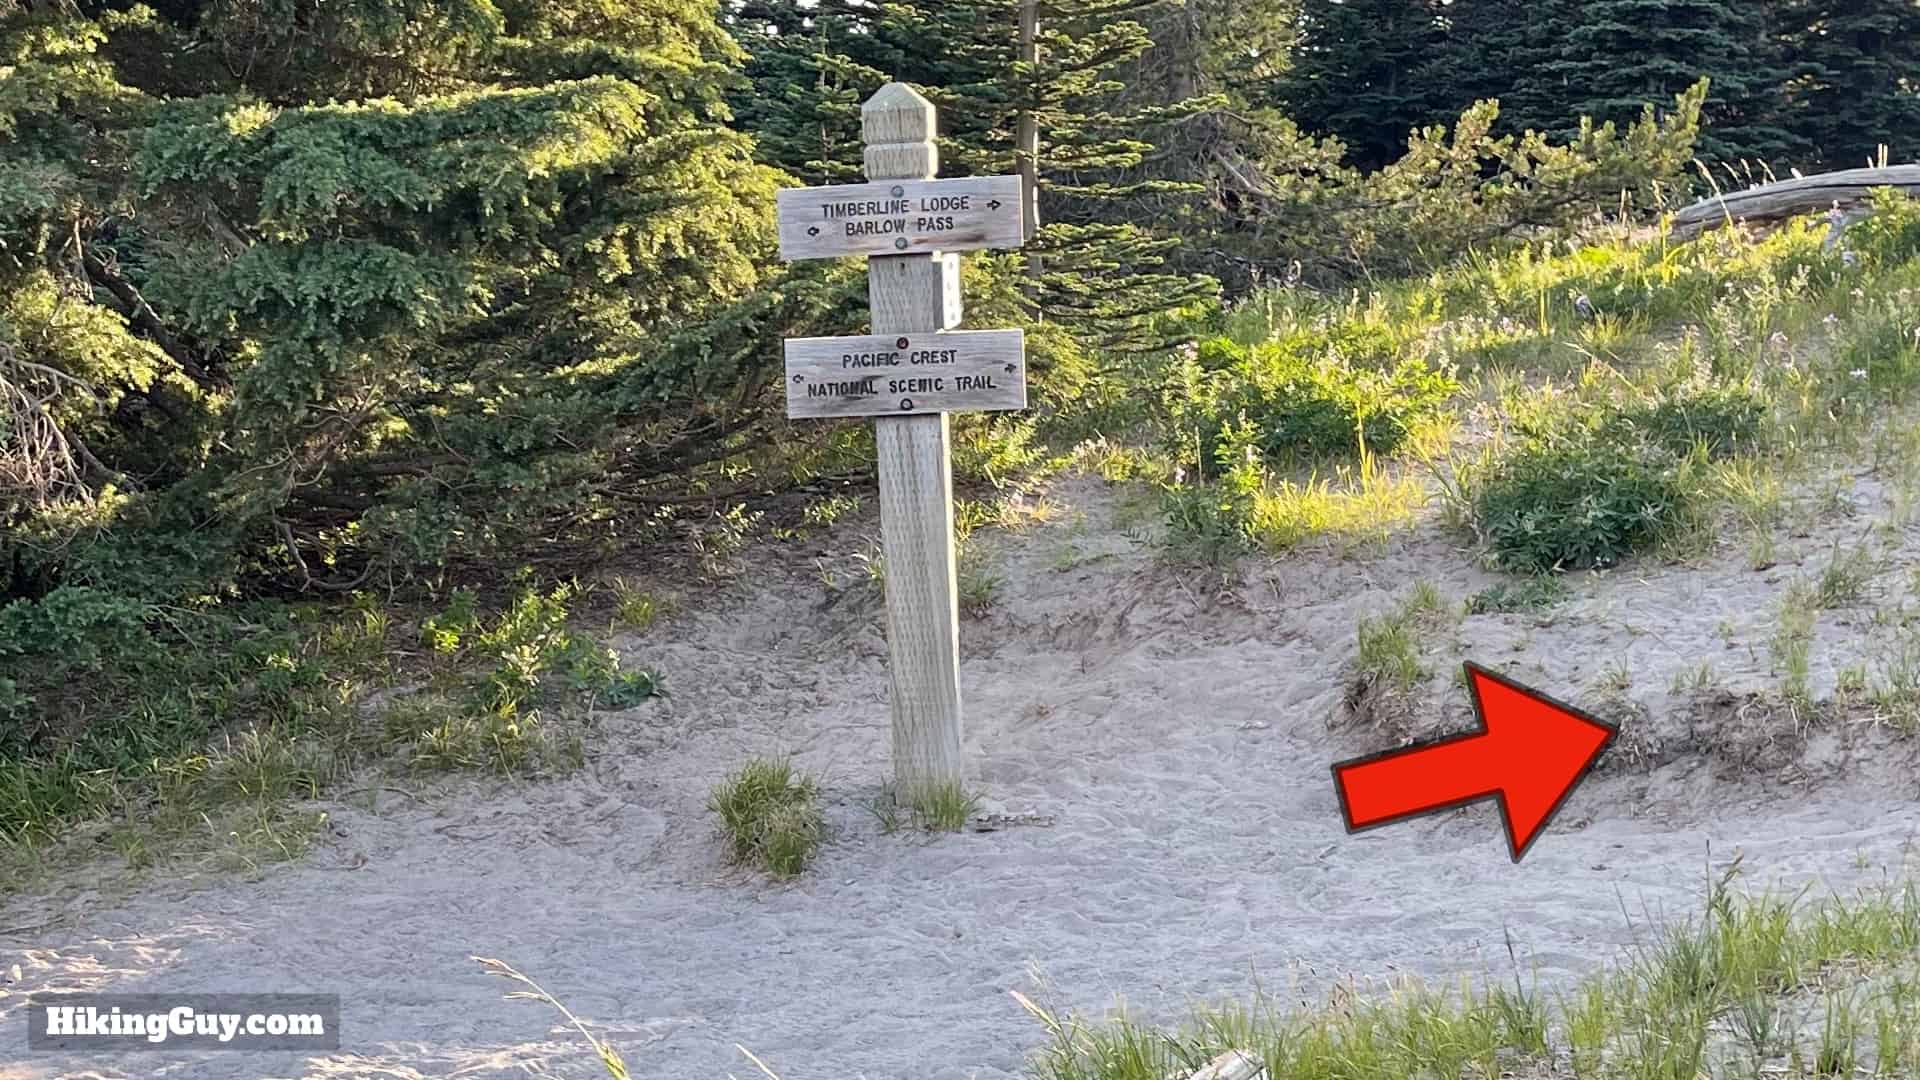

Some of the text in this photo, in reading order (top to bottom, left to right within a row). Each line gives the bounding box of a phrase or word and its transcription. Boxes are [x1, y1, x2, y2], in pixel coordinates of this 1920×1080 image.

[821, 196, 969, 218] TIMBERLINE LODGE
[845, 217, 954, 236] BARLOW PASS
[842, 350, 957, 369] PACIFIC CREST
[808, 375, 997, 398] NATIONAL SCENIC TRAIL
